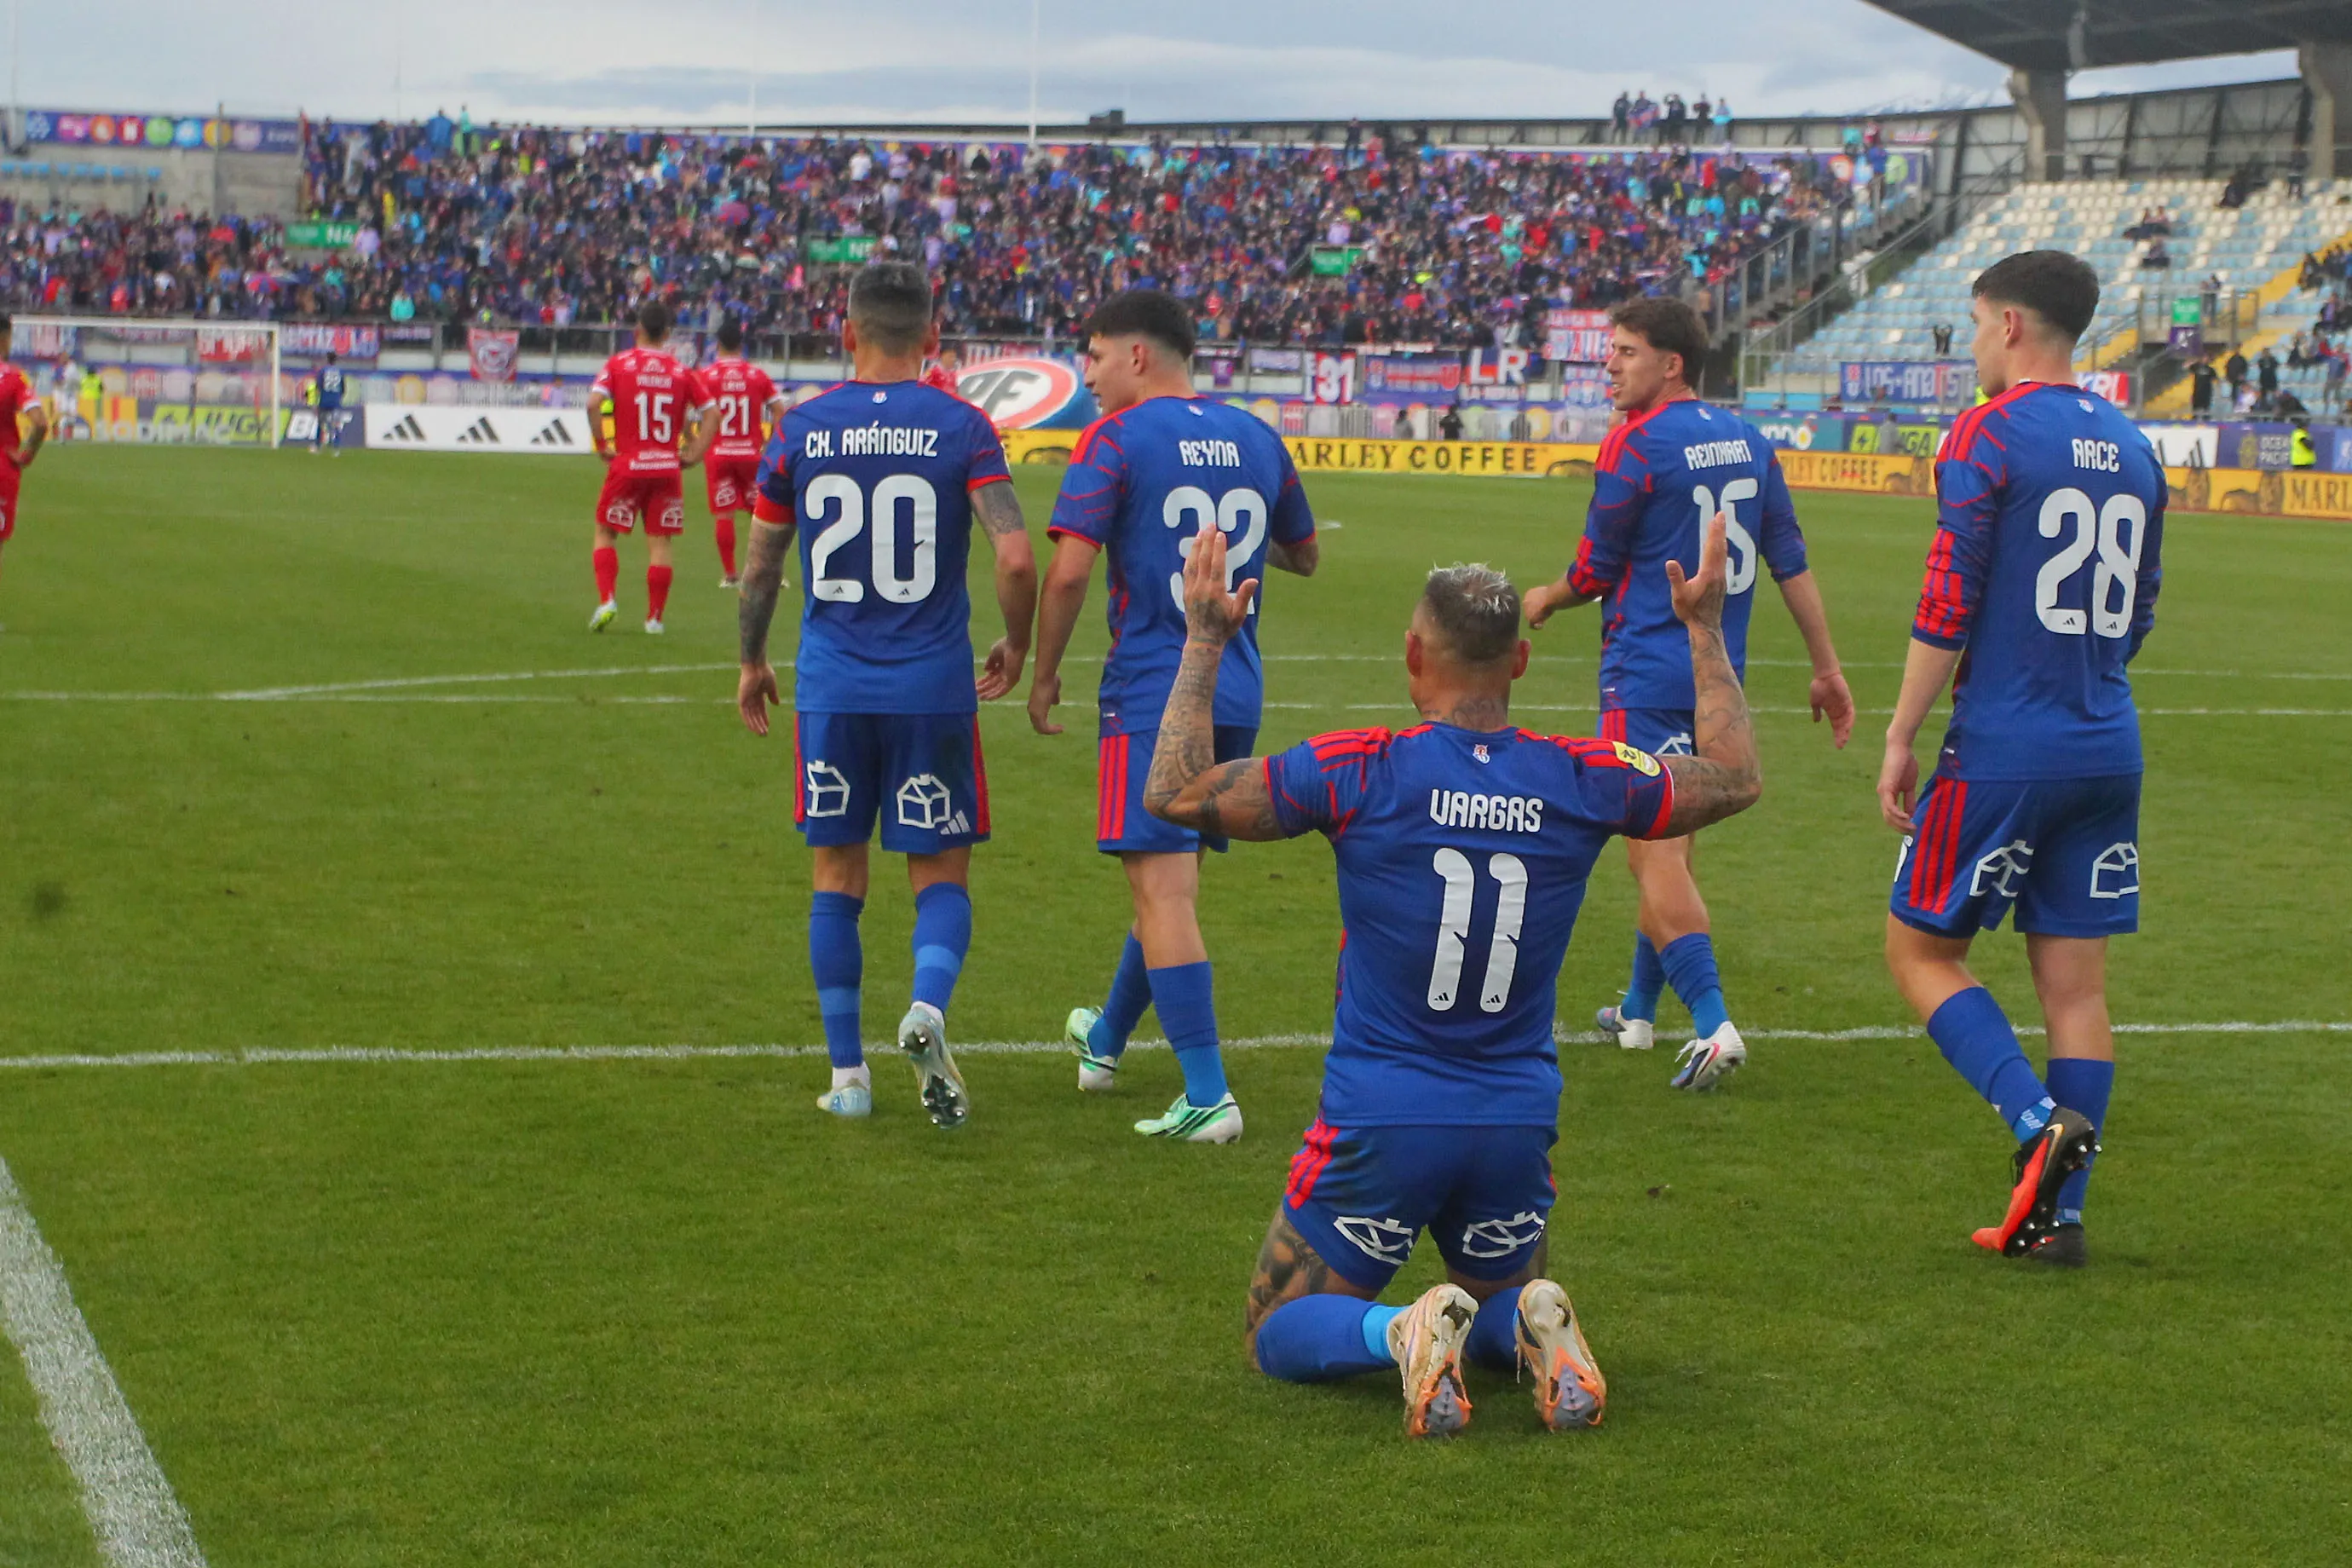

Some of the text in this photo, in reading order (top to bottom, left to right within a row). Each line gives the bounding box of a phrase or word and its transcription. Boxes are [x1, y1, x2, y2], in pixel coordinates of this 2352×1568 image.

[1318, 355, 1356, 403] 31
[634, 391, 674, 443] 15
[719, 395, 751, 436] 21
[805, 420, 939, 458] CH. ARÁNGUIZ
[1179, 440, 1240, 468] REYNA
[1290, 442, 1536, 471] ARLEY COFFEE
[1684, 439, 1753, 470] REINHART
[2072, 438, 2120, 473] ARCE
[805, 474, 937, 604] 20
[1163, 486, 1267, 615] 32
[1692, 477, 1759, 596] 15
[2035, 487, 2146, 639] 28
[1429, 788, 1544, 833] VARGAS
[1427, 847, 1529, 1012] 11
